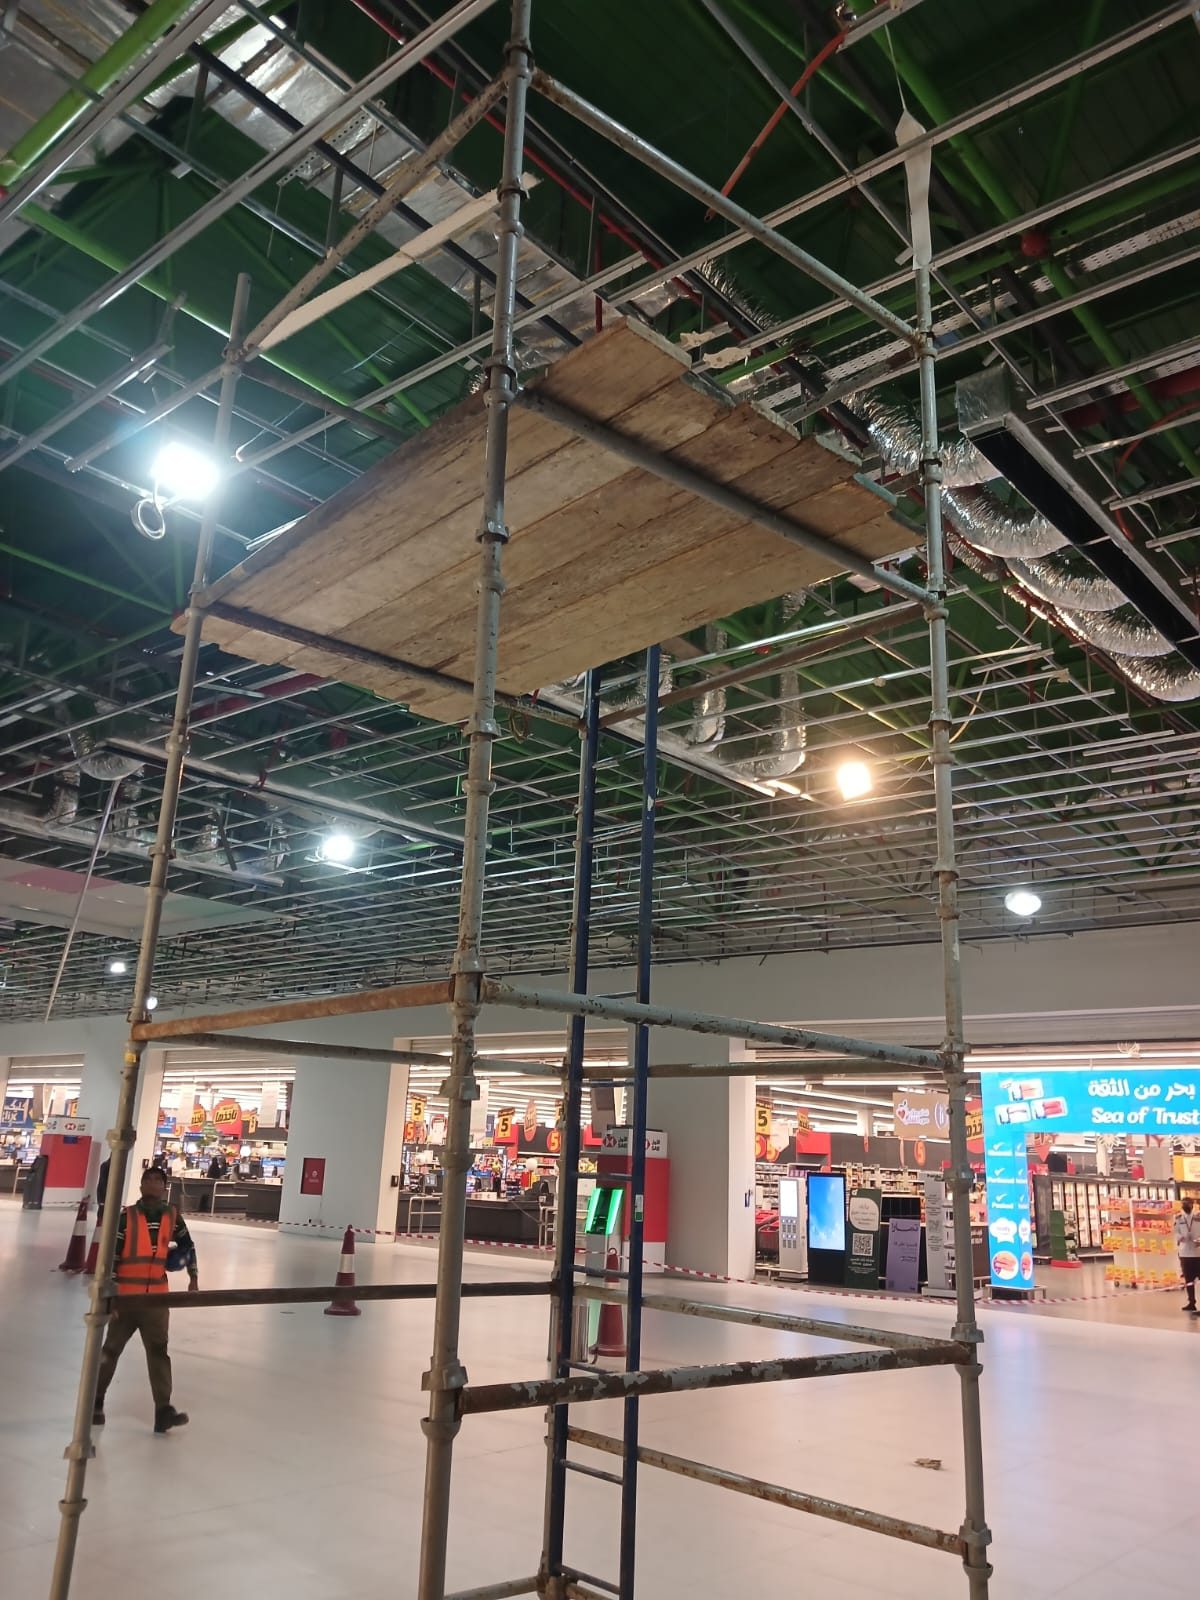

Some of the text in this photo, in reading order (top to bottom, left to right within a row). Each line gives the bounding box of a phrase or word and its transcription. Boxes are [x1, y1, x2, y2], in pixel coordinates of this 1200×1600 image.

[1087, 1077, 1196, 1102] بحر من الثقة
[413, 1102, 423, 1117] 5
[1091, 1105, 1200, 1125] Sea of Trust
[500, 1117, 510, 1133] 5
[757, 1110, 768, 1128] 5
